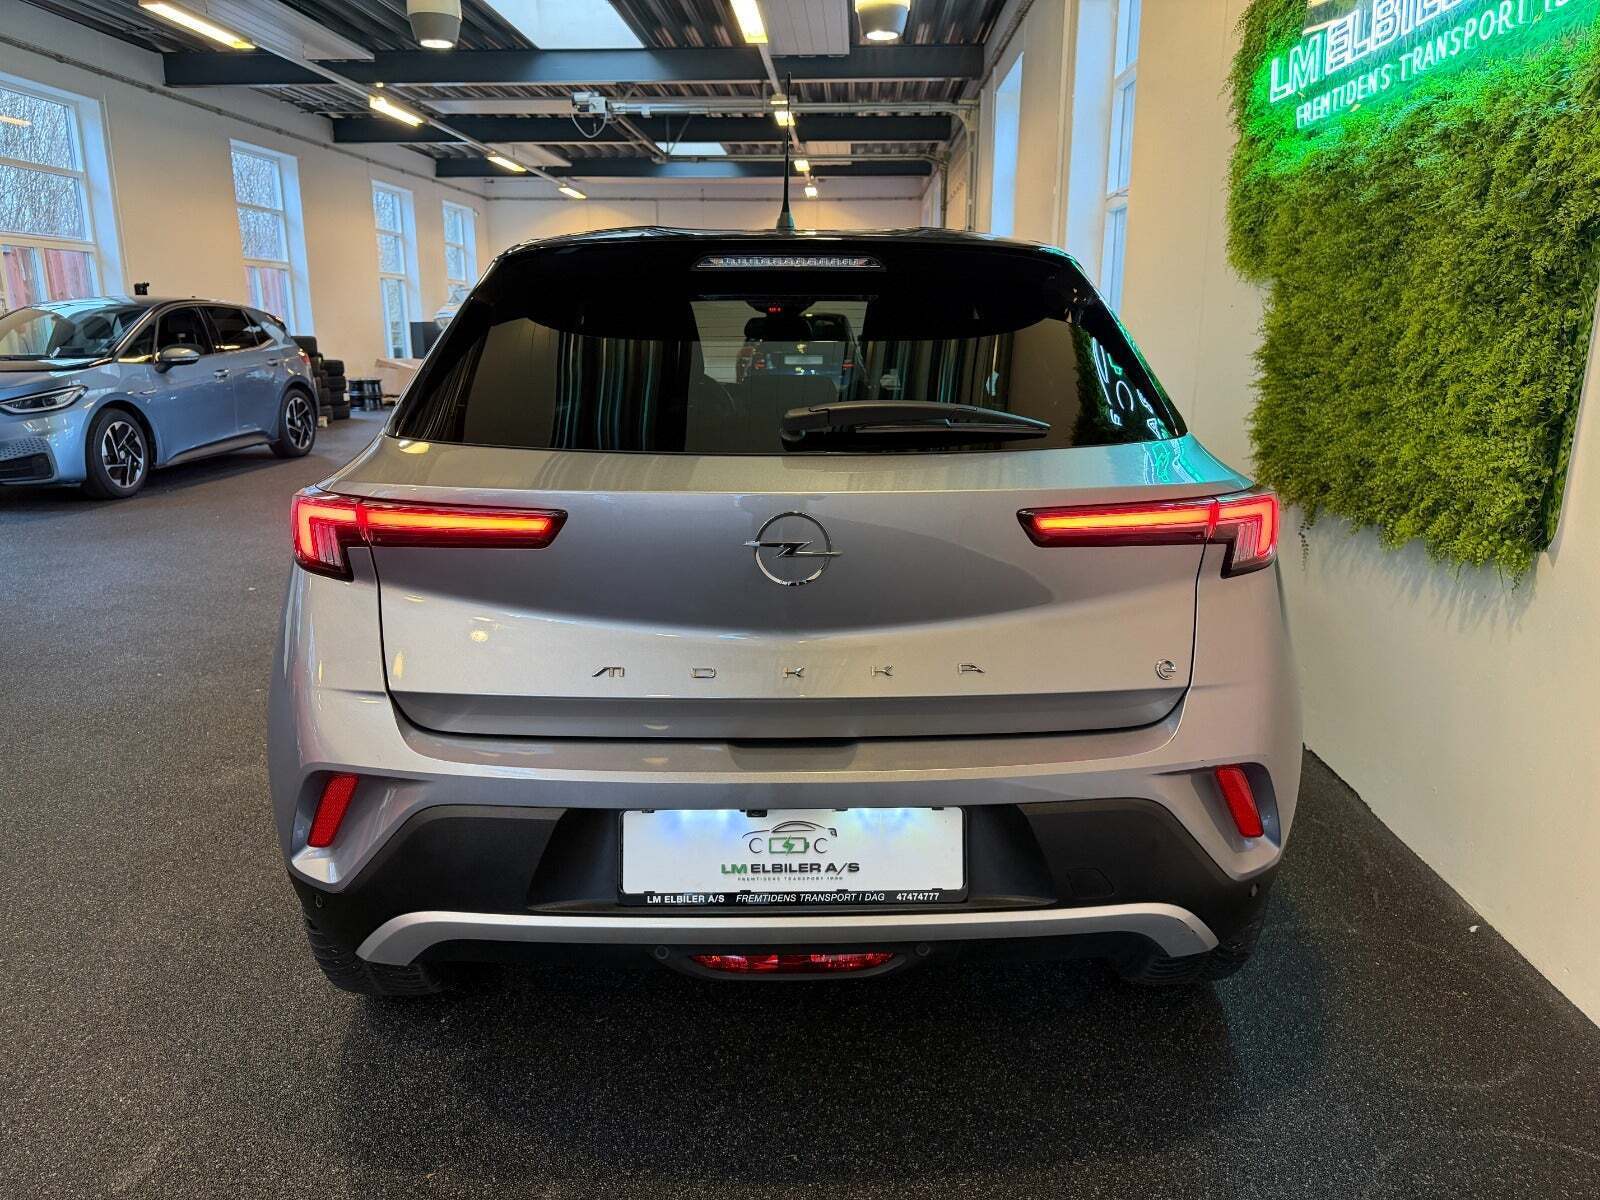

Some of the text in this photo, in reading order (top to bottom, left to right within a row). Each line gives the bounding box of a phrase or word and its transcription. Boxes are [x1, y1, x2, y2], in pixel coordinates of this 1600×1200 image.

[1270, 33, 1322, 103] LM
[1296, 63, 1391, 129] FREMTIDENS
[721, 862, 860, 875] LM ELBILER A/S
[647, 895, 661, 904] LM
[664, 895, 705, 903] ELBILER
[708, 894, 725, 903] A/S
[736, 894, 797, 903] FREMTIDENS
[800, 893, 857, 902] TRANSPORT
[864, 892, 885, 901] DAG
[896, 892, 940, 901] 47474777
